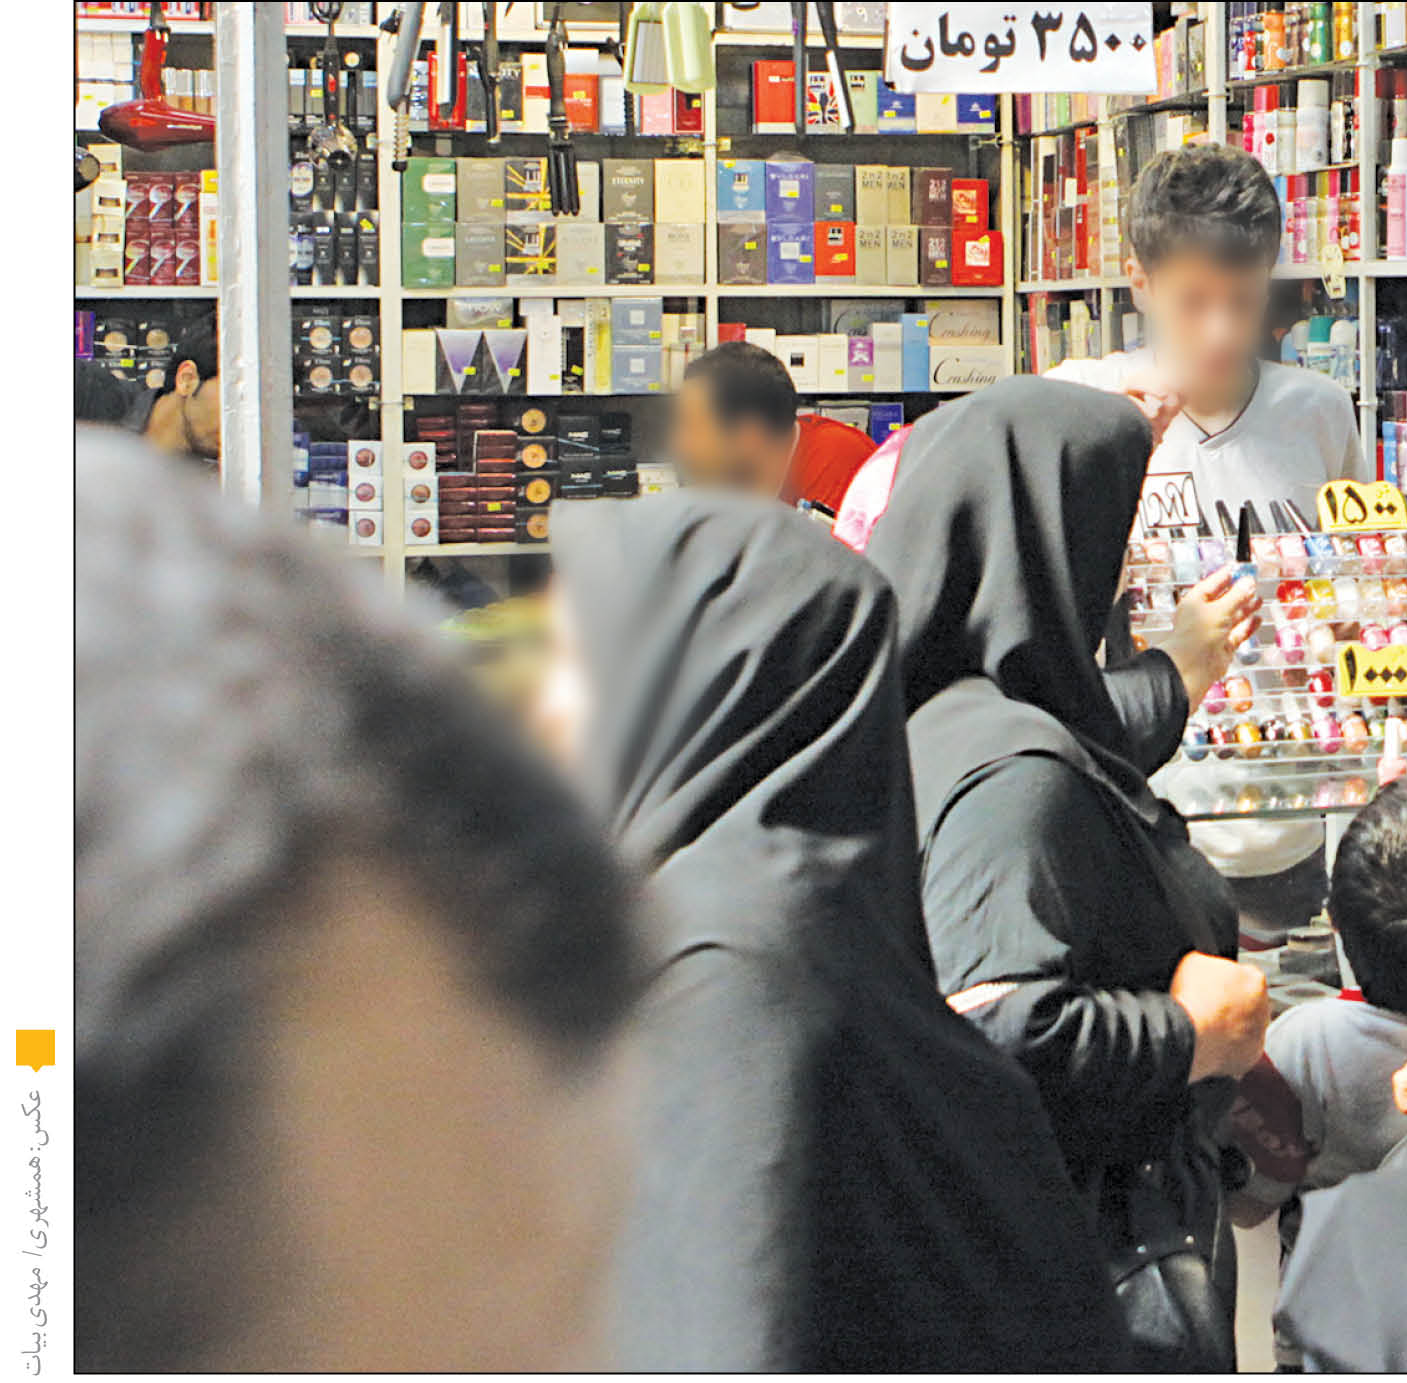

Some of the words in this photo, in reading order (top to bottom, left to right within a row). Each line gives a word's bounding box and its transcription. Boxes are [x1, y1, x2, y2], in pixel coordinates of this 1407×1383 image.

[900, 11, 1017, 73] تومان
[1030, 11, 1149, 63] ۳۵۰۰
[1325, 485, 1397, 524] ۱۵۰۰
[1344, 646, 1407, 691] ۱۰۰۰
